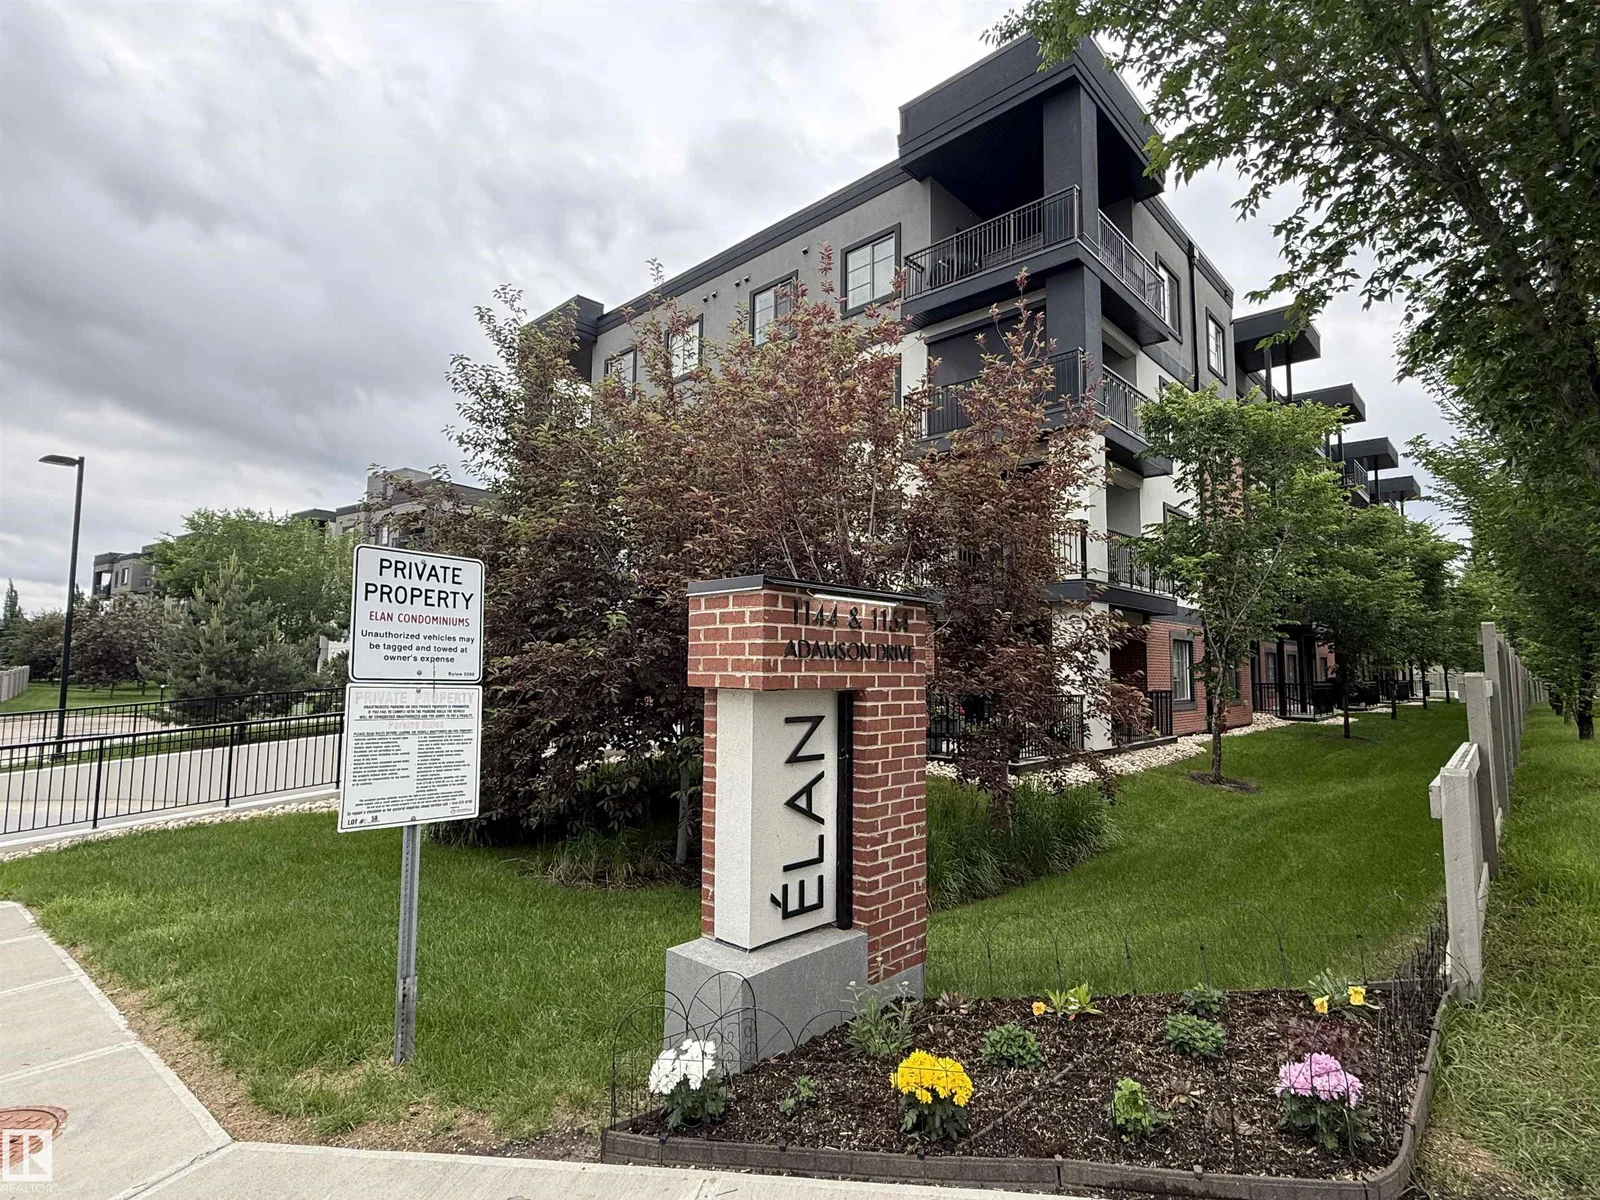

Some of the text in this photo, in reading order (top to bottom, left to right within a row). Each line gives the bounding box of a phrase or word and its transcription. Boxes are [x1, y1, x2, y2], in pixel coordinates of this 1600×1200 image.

[379, 558, 462, 585] PRIVATE
[364, 582, 474, 610] PROPERTY
[369, 611, 470, 627] ELAN CONDOMINIUMS
[793, 599, 839, 627] 1144
[848, 606, 862, 629] &
[361, 629, 475, 644] Unauthorized vehicles may
[369, 642, 380, 650] be
[383, 643, 412, 652] tagged
[434, 645, 458, 653] towed
[784, 639, 915, 662] ADAMSON DRIVE
[355, 690, 474, 704] PRIVATE PROPERTY
[388, 721, 419, 730] Parking
[347, 818, 358, 826] LOT
[770, 715, 826, 920] ÉLAN
